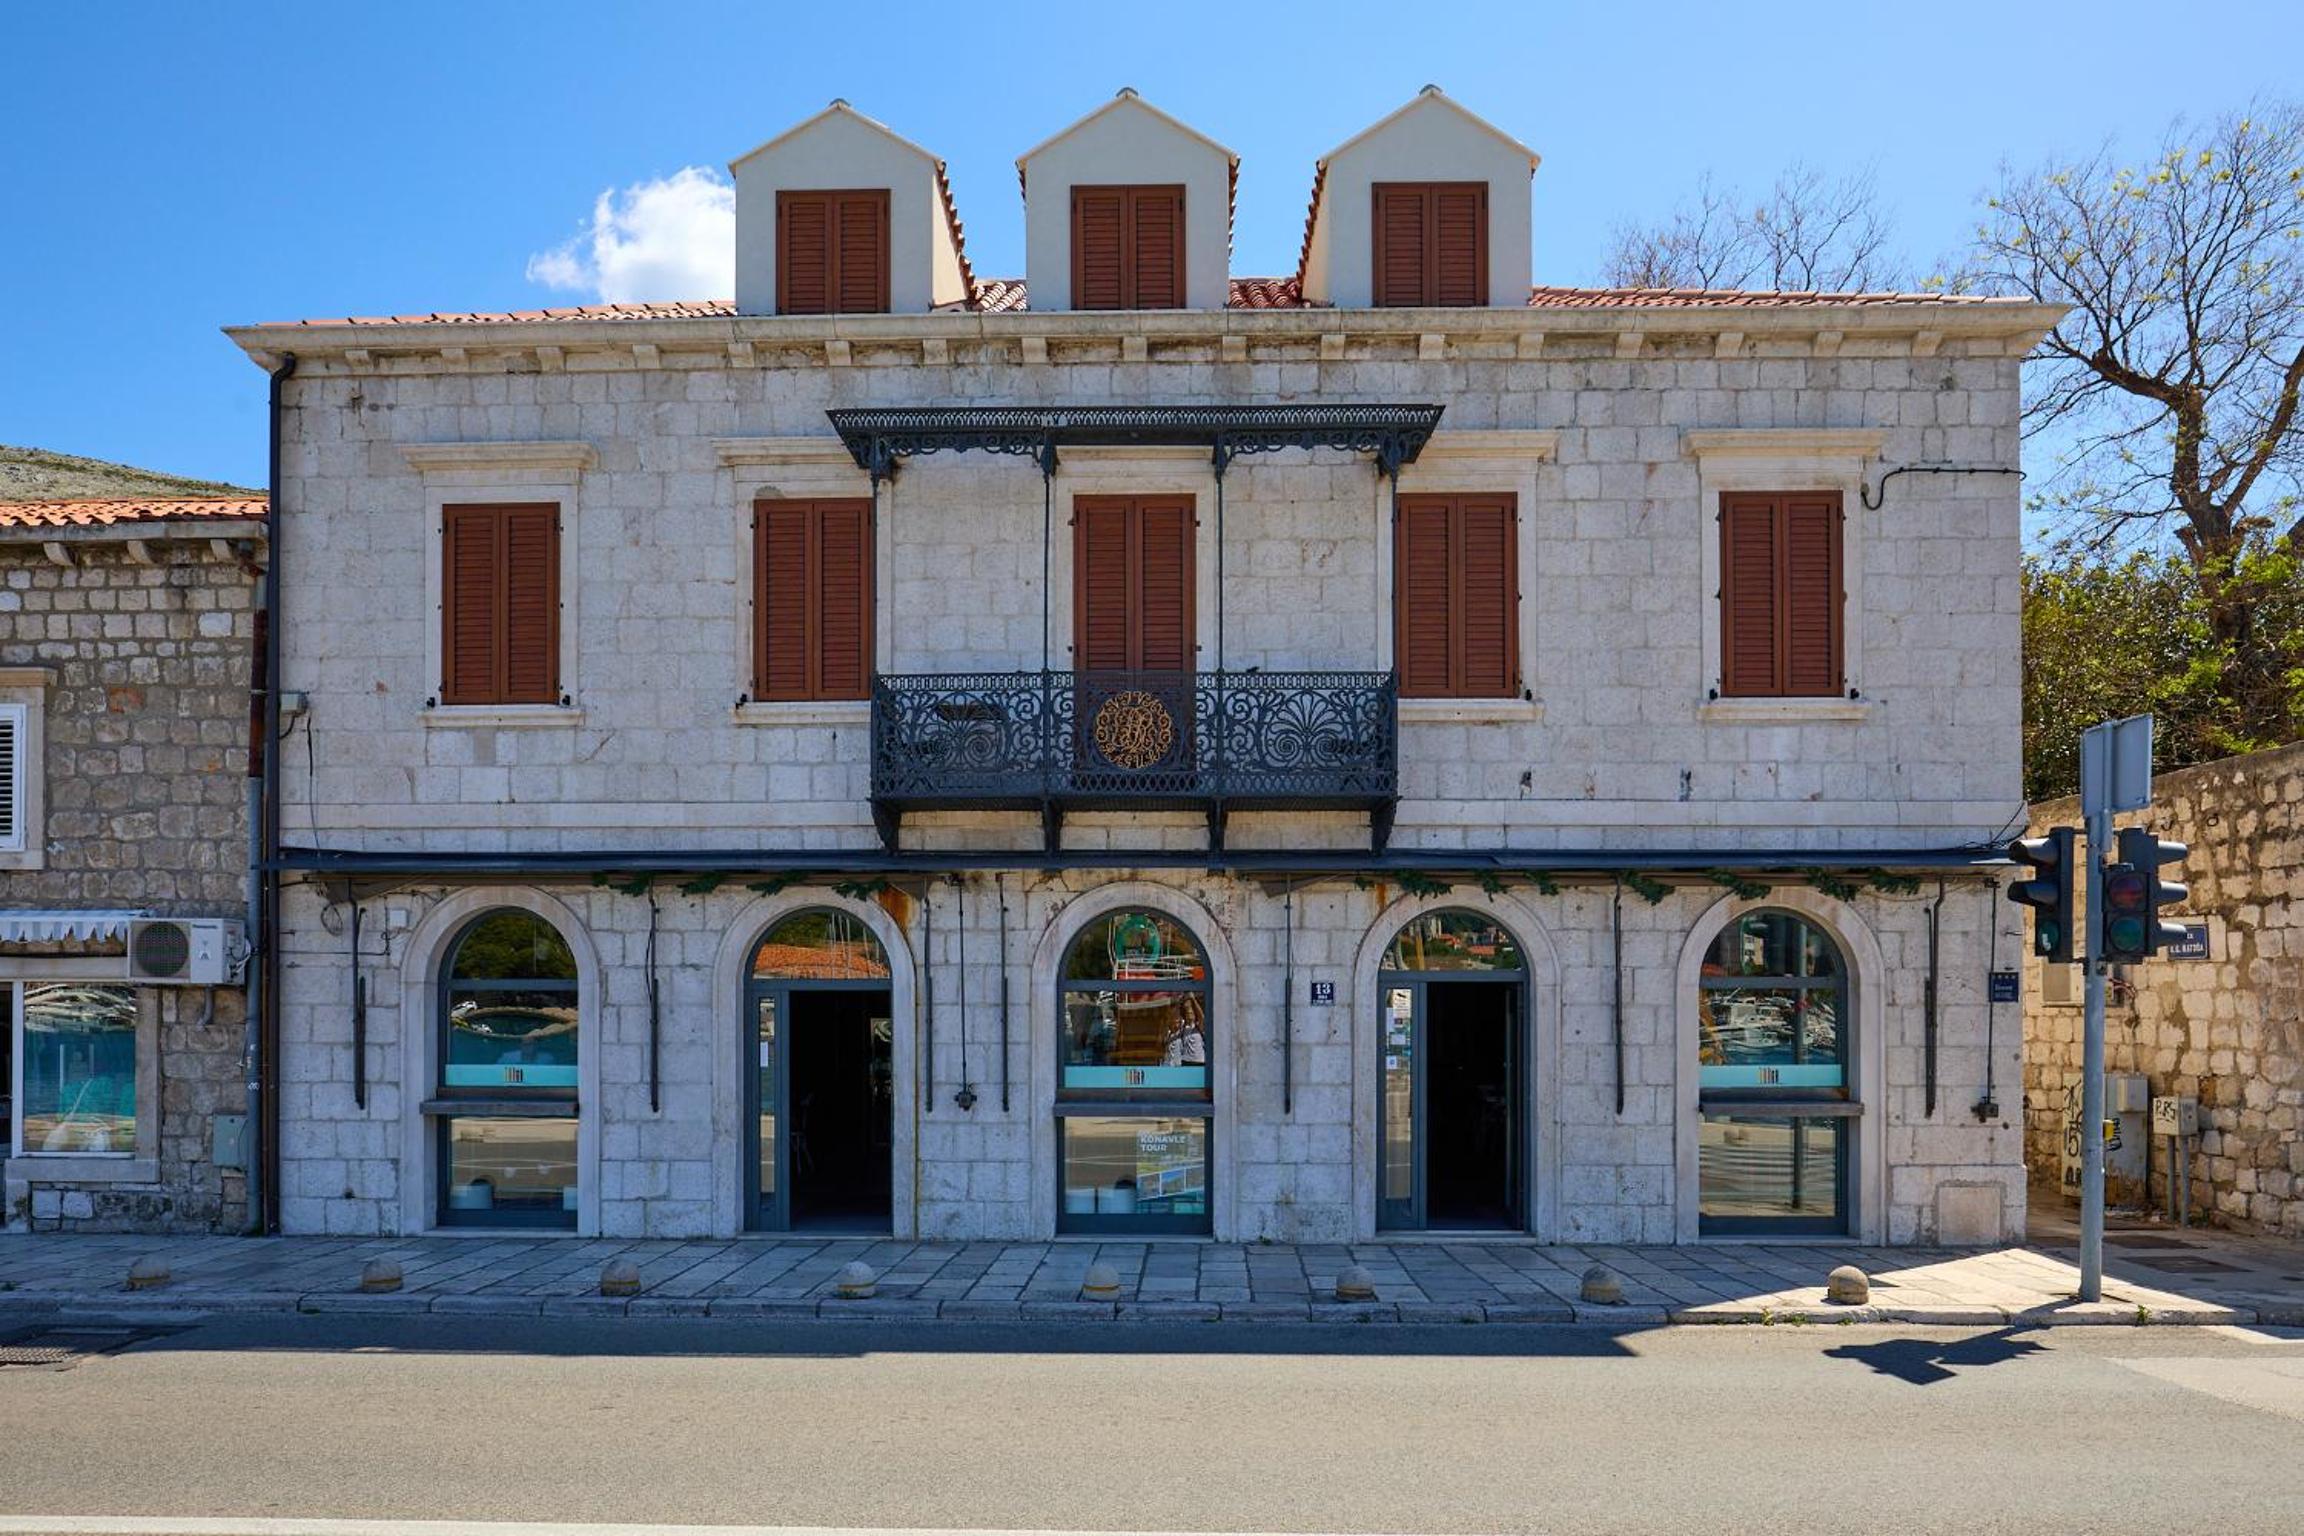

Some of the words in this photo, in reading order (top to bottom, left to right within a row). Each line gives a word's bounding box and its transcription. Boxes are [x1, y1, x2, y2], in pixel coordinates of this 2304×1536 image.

[1315, 983, 1331, 995] 13
[1140, 1134, 1186, 1144] KONAVLE
[1140, 1144, 1168, 1152] TOUR
